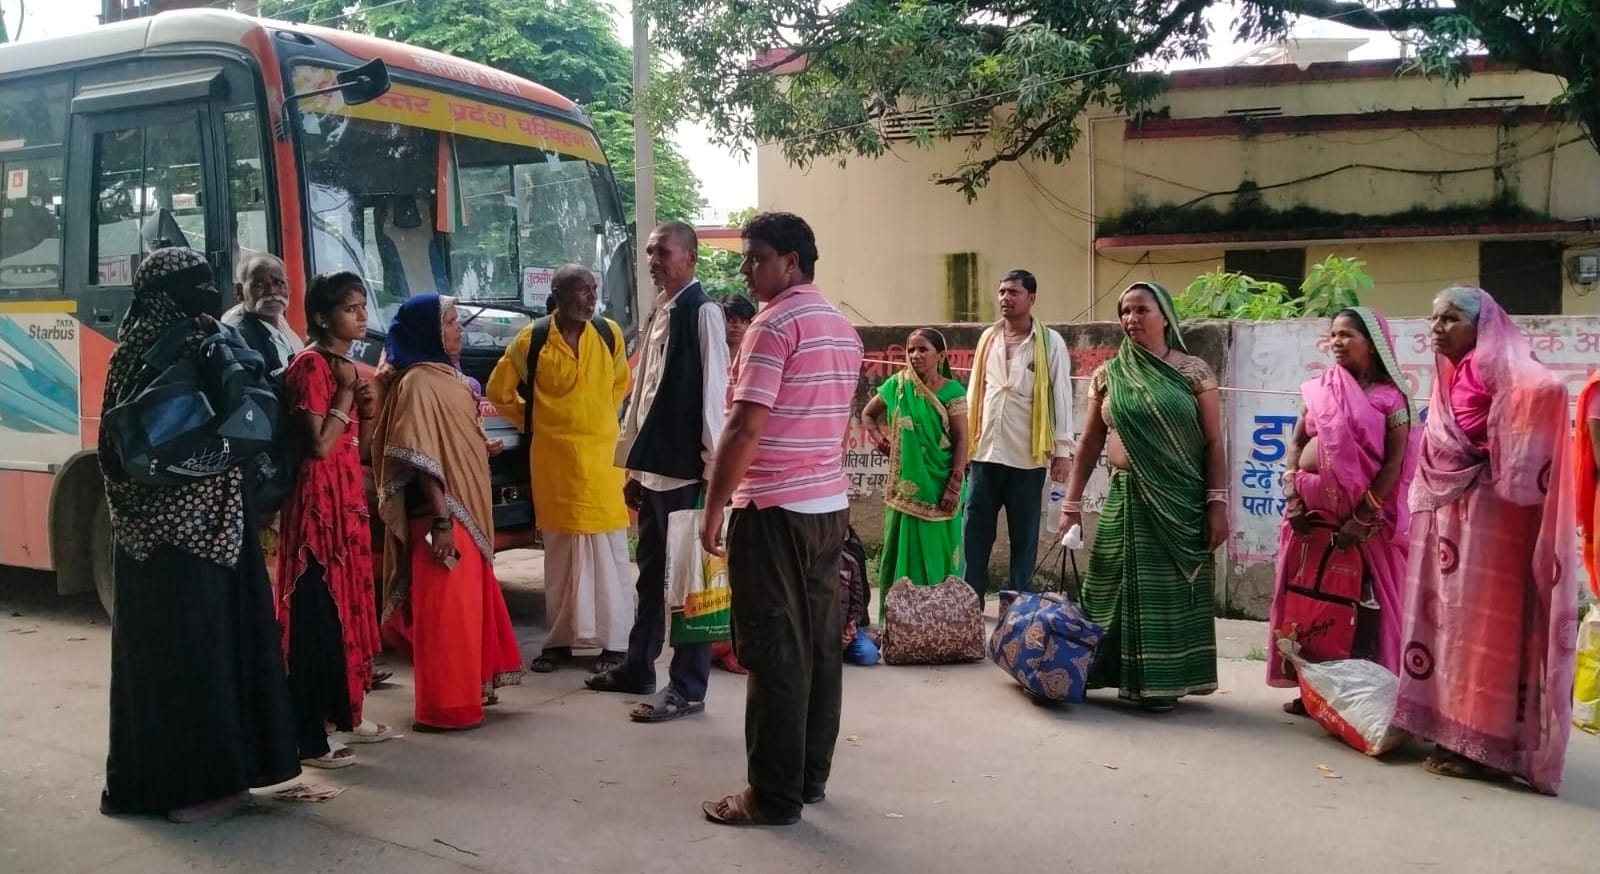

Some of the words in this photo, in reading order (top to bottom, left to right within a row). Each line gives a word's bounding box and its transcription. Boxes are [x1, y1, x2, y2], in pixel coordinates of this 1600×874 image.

[374, 92, 431, 114] त्तर
[56, 319, 74, 328] TATA
[28, 324, 75, 340] Starbus
